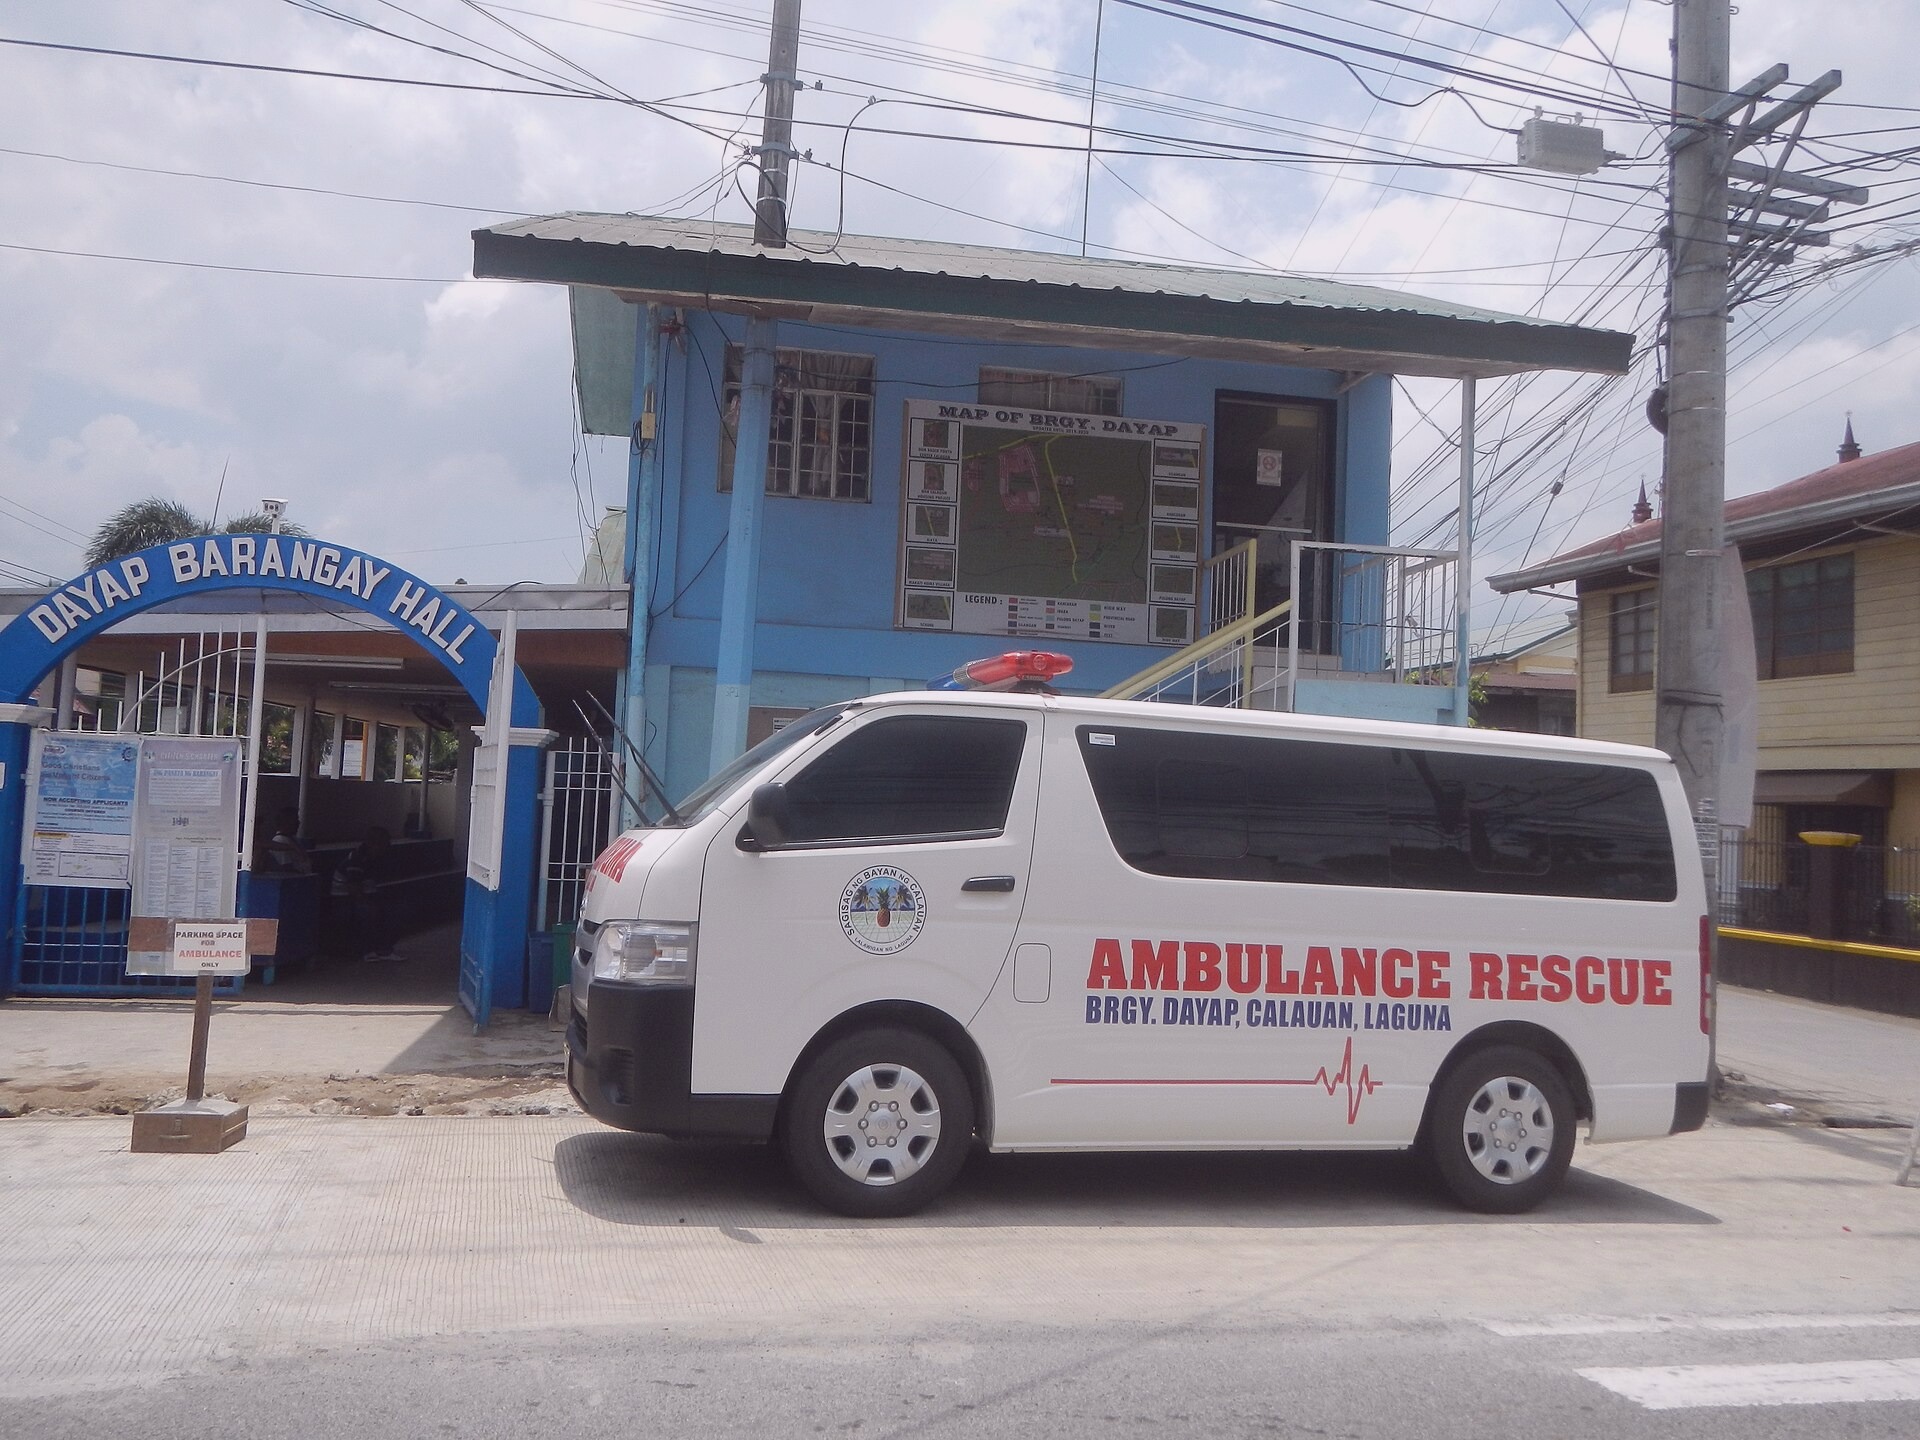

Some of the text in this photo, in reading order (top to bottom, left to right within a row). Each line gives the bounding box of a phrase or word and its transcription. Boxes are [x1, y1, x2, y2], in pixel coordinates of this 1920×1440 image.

[938, 405, 1178, 437] MAP OF BRGY. DAYAP
[28, 537, 475, 665] DAYAP BARANGAY HALL
[965, 594, 998, 605] LEGEND
[841, 867, 925, 936] SAGISAG NG BAYAN NG CALAUAN
[175, 930, 243, 939] PARKING SPACE
[178, 950, 242, 958] AMBULANCE
[1086, 938, 1673, 1006] AMBULANCE RESCUE
[1085, 995, 1452, 1032] BRGY. DAYAP, CALAUAN, LAGUNA
